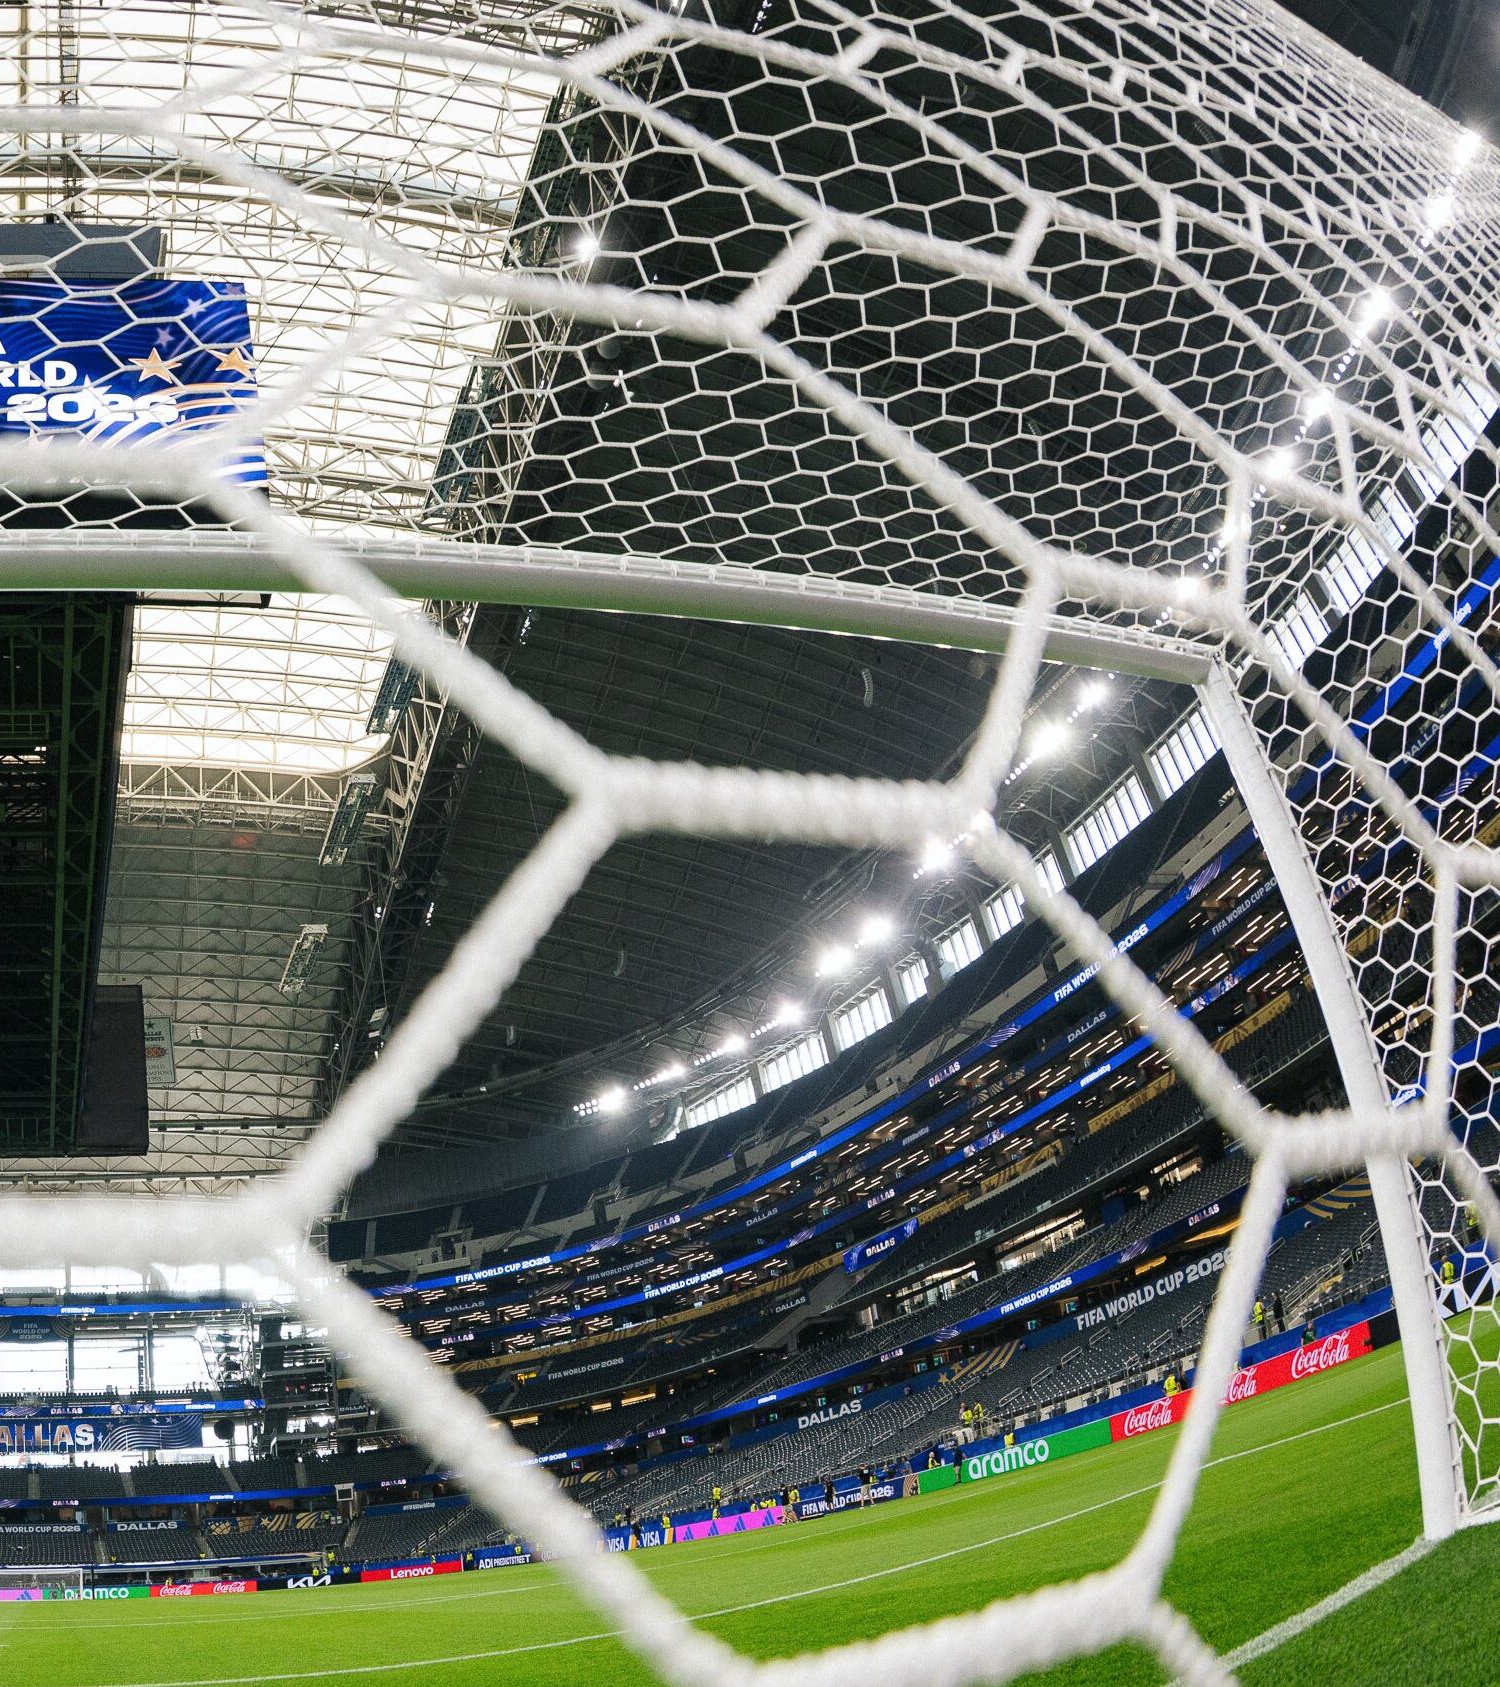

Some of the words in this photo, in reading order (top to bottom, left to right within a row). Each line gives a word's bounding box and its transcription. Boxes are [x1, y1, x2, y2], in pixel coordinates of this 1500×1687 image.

[7, 393, 180, 423] 2026
[1212, 920, 1227, 936] FIFA
[1225, 901, 1250, 926] WORLD
[1250, 890, 1265, 905] CUP
[1264, 876, 1278, 893] 20
[1054, 983, 1073, 1002] FIFA
[1117, 924, 1148, 953] 2026
[1067, 1011, 1107, 1043] DALLAS
[928, 1061, 961, 1088] DALLAS
[867, 1188, 895, 1208] DALLAS
[648, 1215, 681, 1232] DALLAS
[746, 1207, 778, 1226] DALLAS
[1188, 1204, 1220, 1227] DALLAS
[865, 1237, 896, 1257] DALLAS
[455, 1273, 474, 1284] FIFA
[474, 1267, 504, 1281] WORLD
[504, 1263, 522, 1274] CUP
[521, 1256, 551, 1269] 2026
[587, 1274, 600, 1282] FIFA
[600, 1267, 623, 1280] WORLD
[622, 1263, 635, 1273] CUP
[645, 1289, 660, 1299] FIFA
[660, 1281, 686, 1296] WORLD
[686, 1276, 700, 1286] CUP
[700, 1267, 724, 1283] 2026
[775, 1296, 806, 1313] DALLAS
[1001, 1305, 1014, 1315] FIFA
[1013, 1295, 1037, 1310] WORLD
[1036, 1289, 1050, 1299] CUP
[1049, 1277, 1073, 1293] 2026
[1076, 1308, 1106, 1331] FIFA
[1107, 1284, 1155, 1317] WORLD
[1155, 1271, 1184, 1296] CUP
[445, 1301, 485, 1312] DALLAS
[442, 1333, 474, 1345] DALLAS
[1291, 1330, 1350, 1379] Coca-Cola
[548, 1372, 563, 1381] FIFA
[562, 1366, 587, 1378] WORLD
[587, 1363, 601, 1371] CUP
[600, 1357, 624, 1368] 2026
[50, 1407, 83, 1415] DALLAS
[797, 1398, 863, 1429] DALLAS
[1124, 1397, 1173, 1436] Coca-Cola
[968, 1438, 1049, 1480] aramco
[802, 1503, 819, 1516] FIFA
[34, 1525, 52, 1533] CUP
[52, 1525, 81, 1533] 2026
[117, 1521, 178, 1531] DALLAS
[607, 1537, 625, 1552] VISA
[640, 1531, 661, 1547] VISA
[478, 1559, 493, 1570] ADI
[493, 1554, 531, 1567] PREDICTSTREET
[287, 1575, 331, 1589] KIA
[390, 1567, 434, 1579] Lenovo
[160, 1585, 192, 1597] Coca-Cola
[213, 1582, 246, 1593] Coca-Cola
